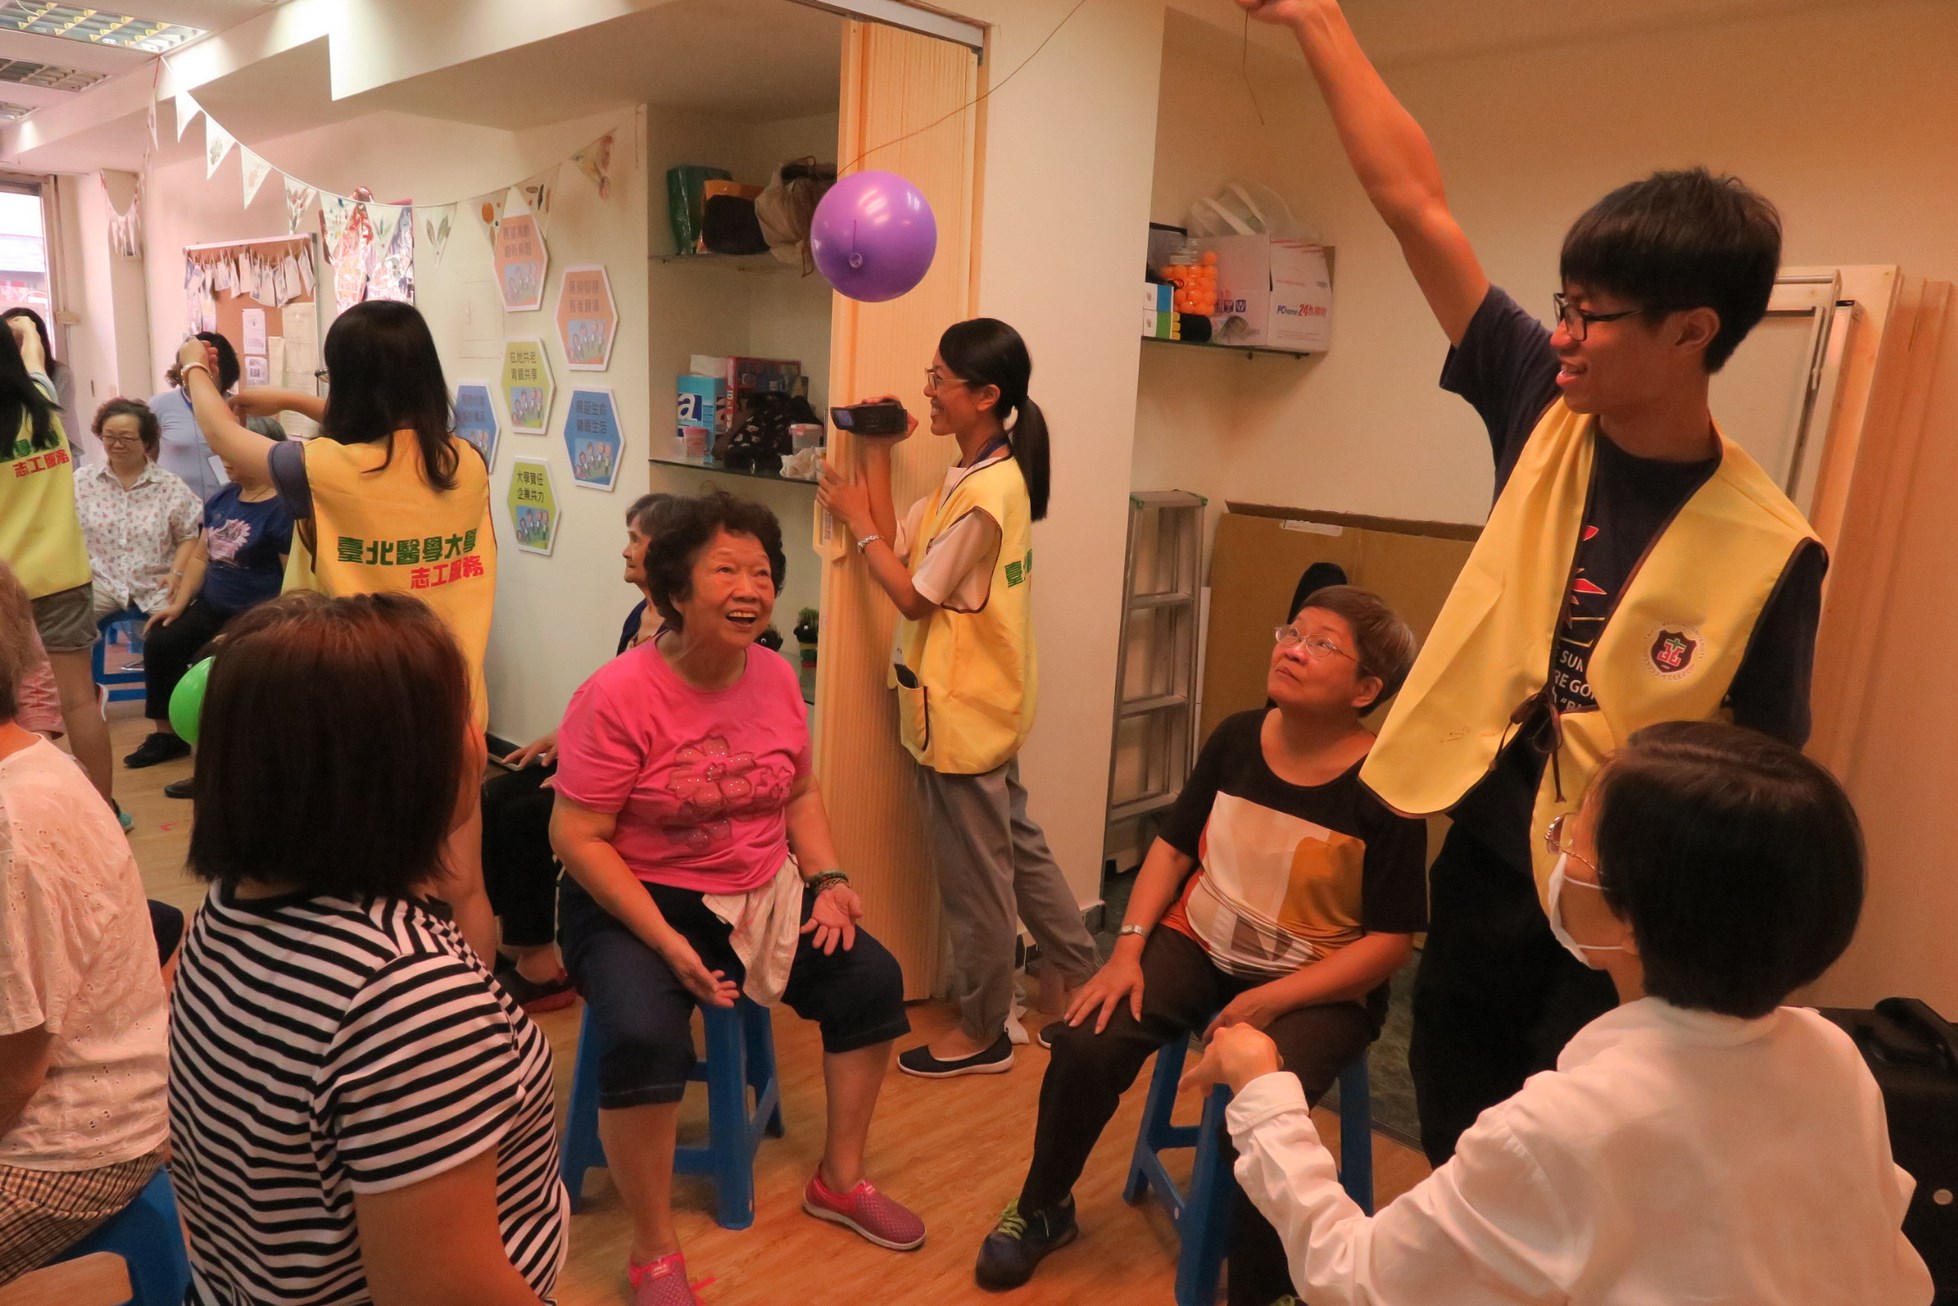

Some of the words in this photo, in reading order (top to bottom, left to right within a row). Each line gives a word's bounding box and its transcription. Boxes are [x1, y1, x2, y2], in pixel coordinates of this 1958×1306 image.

[12, 449, 70, 478] 志工服務
[516, 470, 544, 486] 大學責任
[337, 527, 478, 566] 臺北醫學大學
[410, 555, 484, 590] 志工服務
